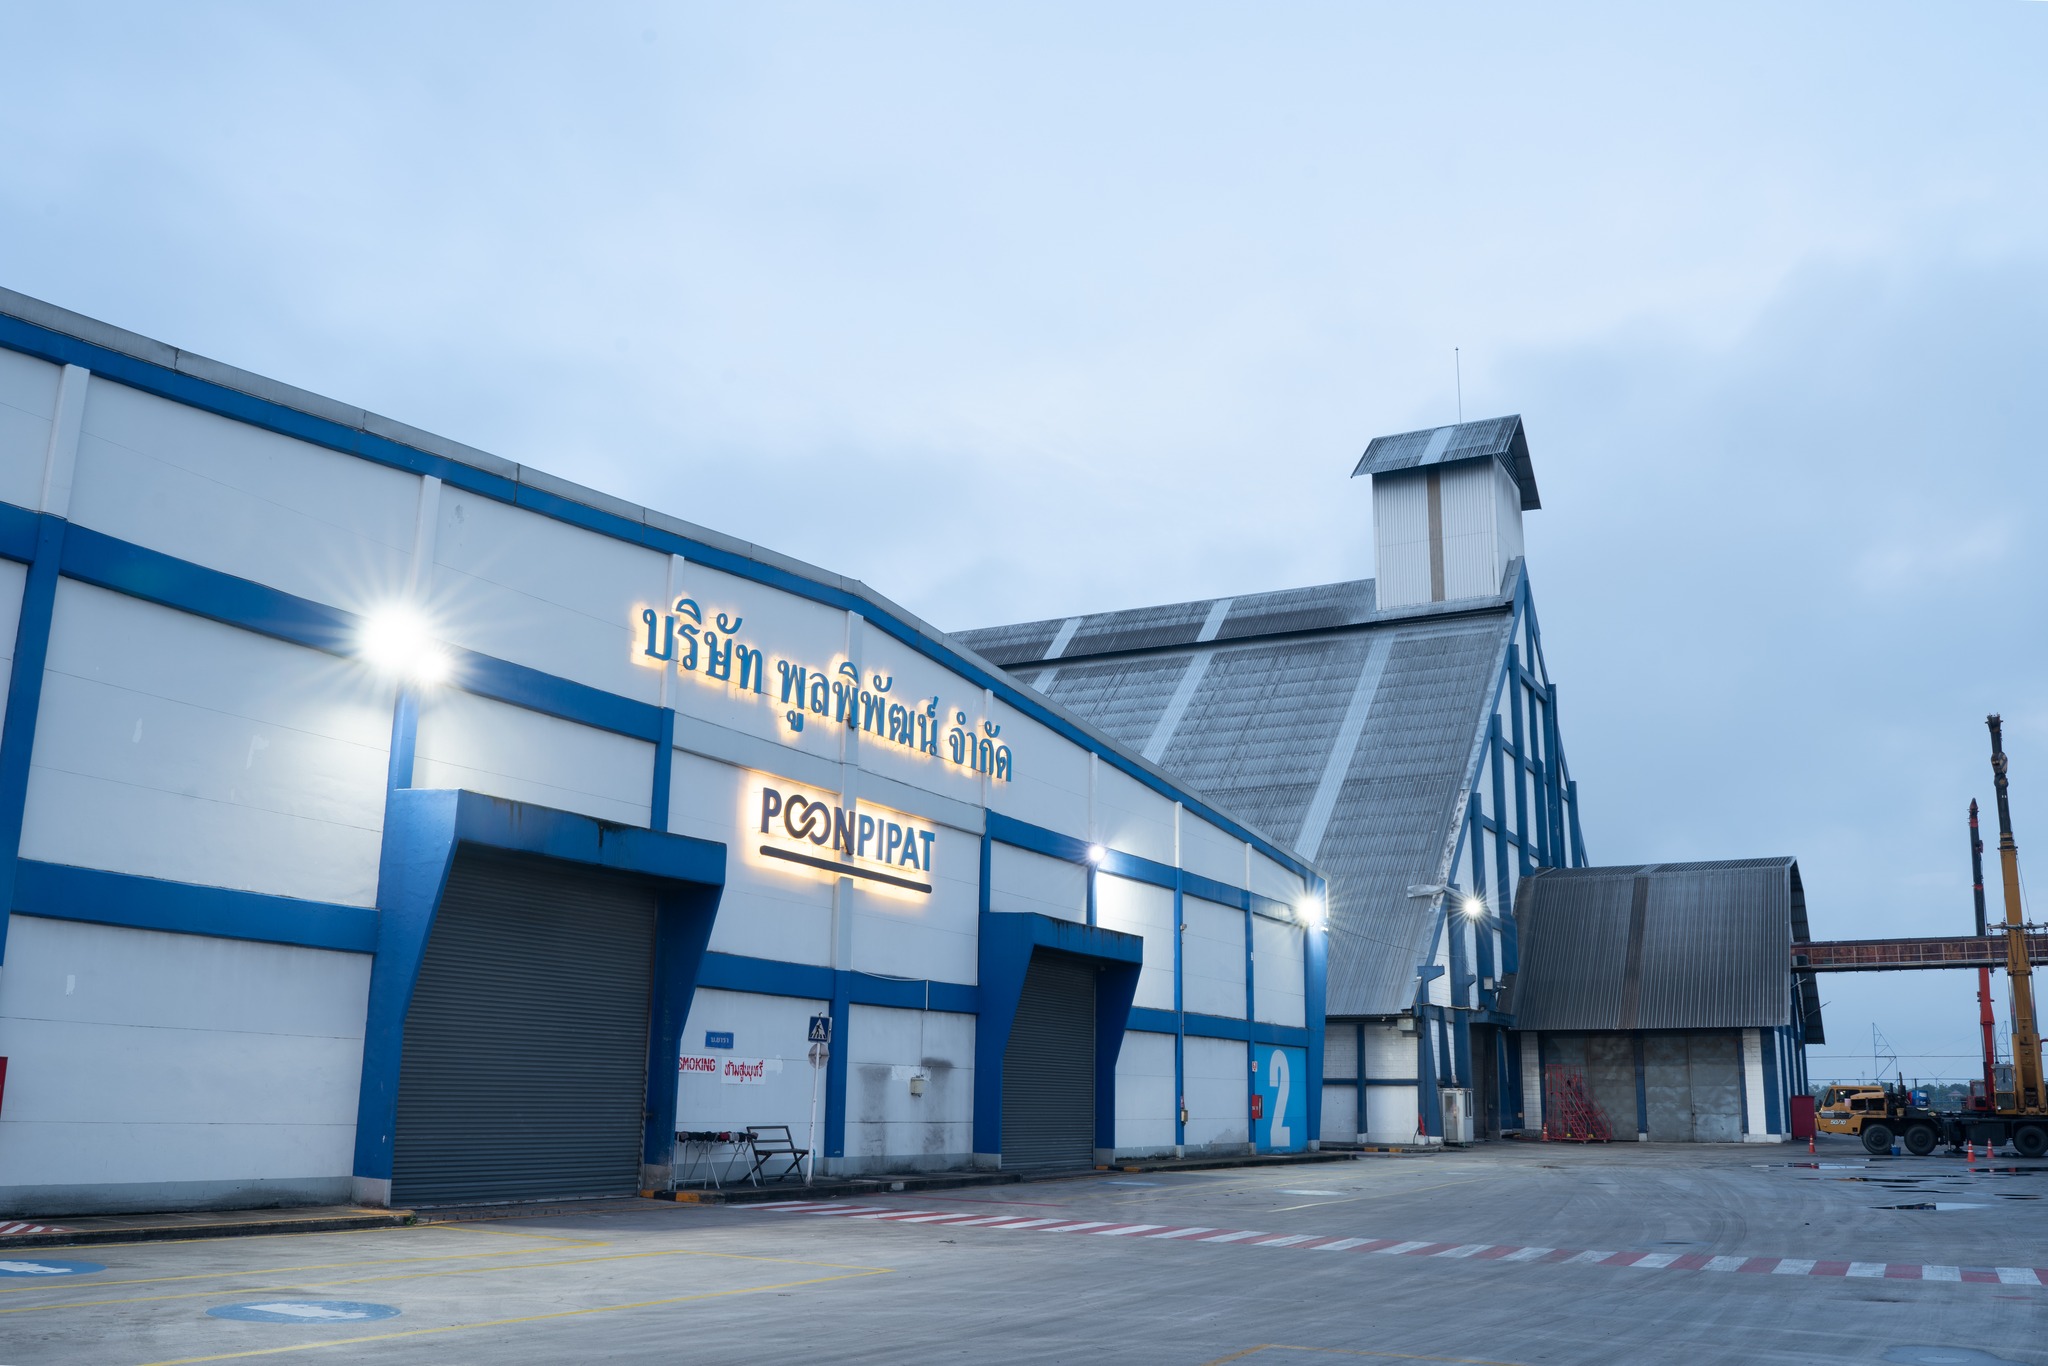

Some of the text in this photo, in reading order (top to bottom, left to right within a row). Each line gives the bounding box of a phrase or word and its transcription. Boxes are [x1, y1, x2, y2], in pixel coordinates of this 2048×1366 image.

[642, 598, 1012, 782] บริษัท พูลพิพัฒน์ จำกัด
[760, 787, 936, 872] POONPIPAT
[678, 1056, 716, 1072] SMOKING
[1269, 1049, 1291, 1147] 2
